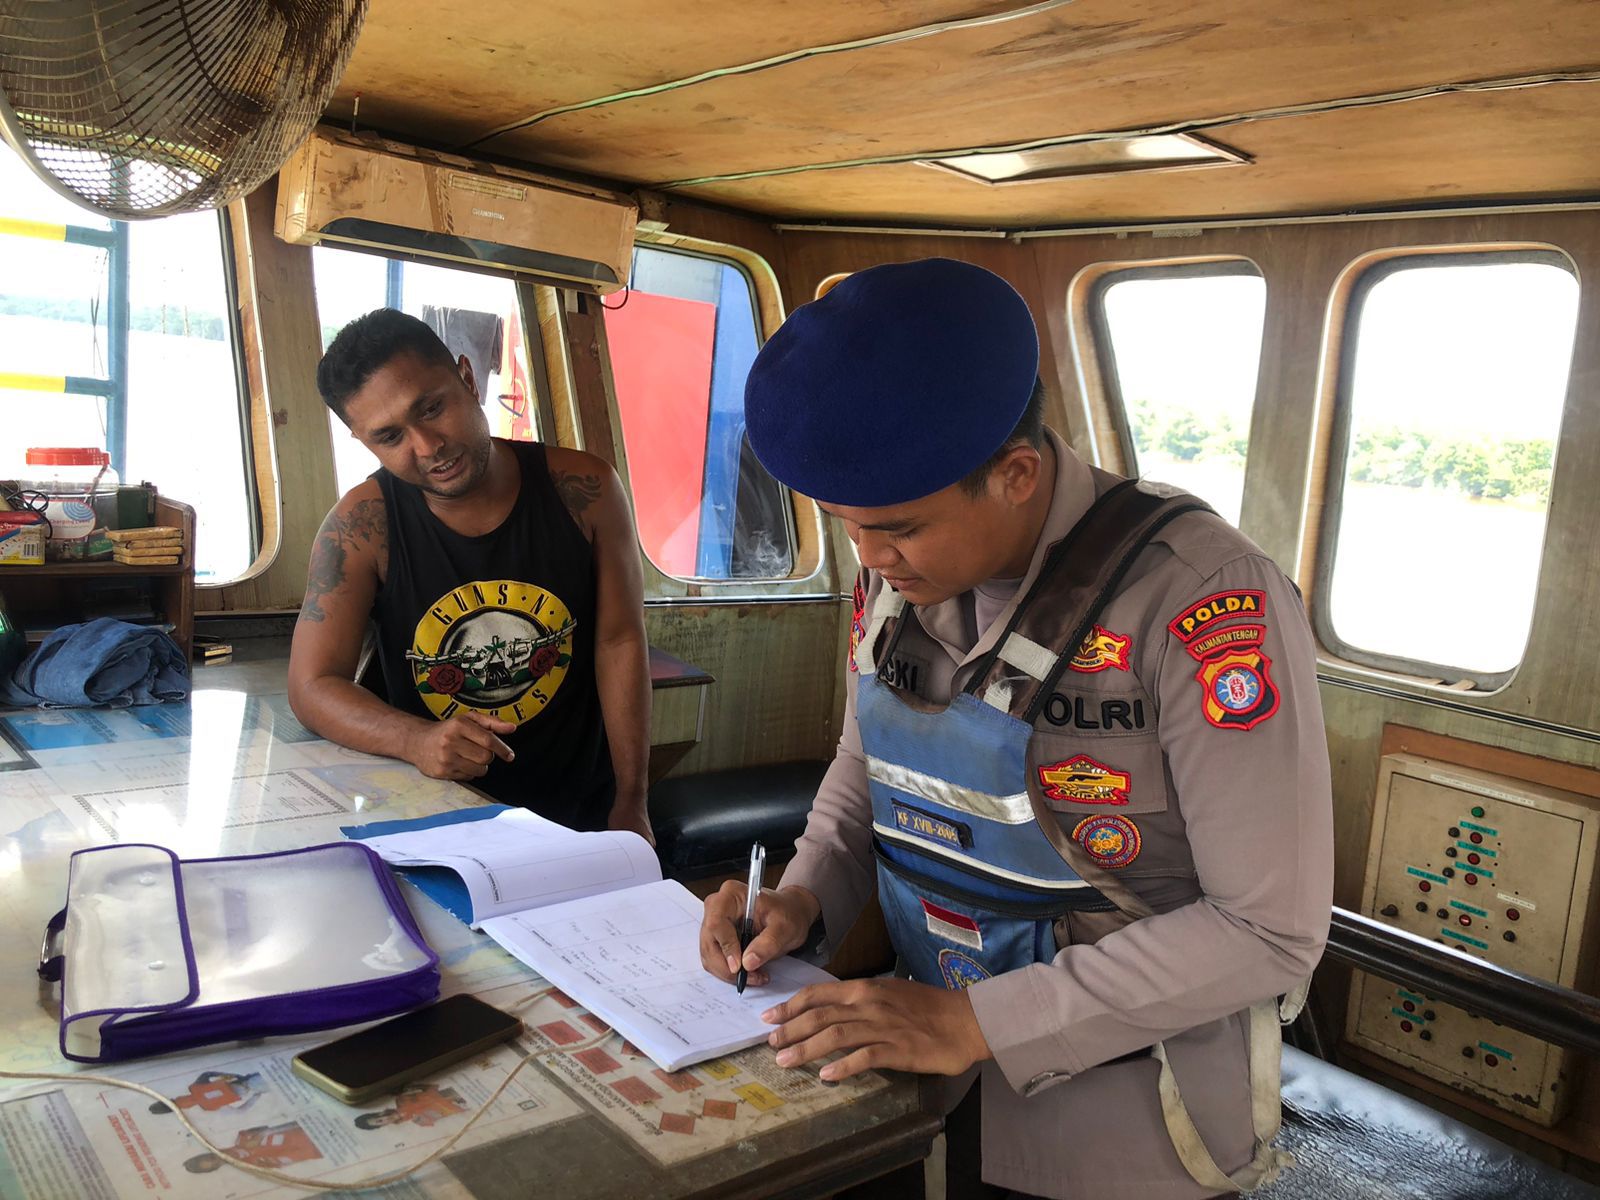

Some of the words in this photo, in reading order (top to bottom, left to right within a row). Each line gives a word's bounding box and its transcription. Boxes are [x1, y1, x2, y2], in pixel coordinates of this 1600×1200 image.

[431, 583, 509, 626] GUNS
[1181, 595, 1256, 633] POLDA
[1194, 631, 1233, 655] KALIMANTAN
[1232, 629, 1259, 641] TENGAH
[1043, 692, 1146, 730] OLRI
[1058, 787, 1114, 800] SNIPER
